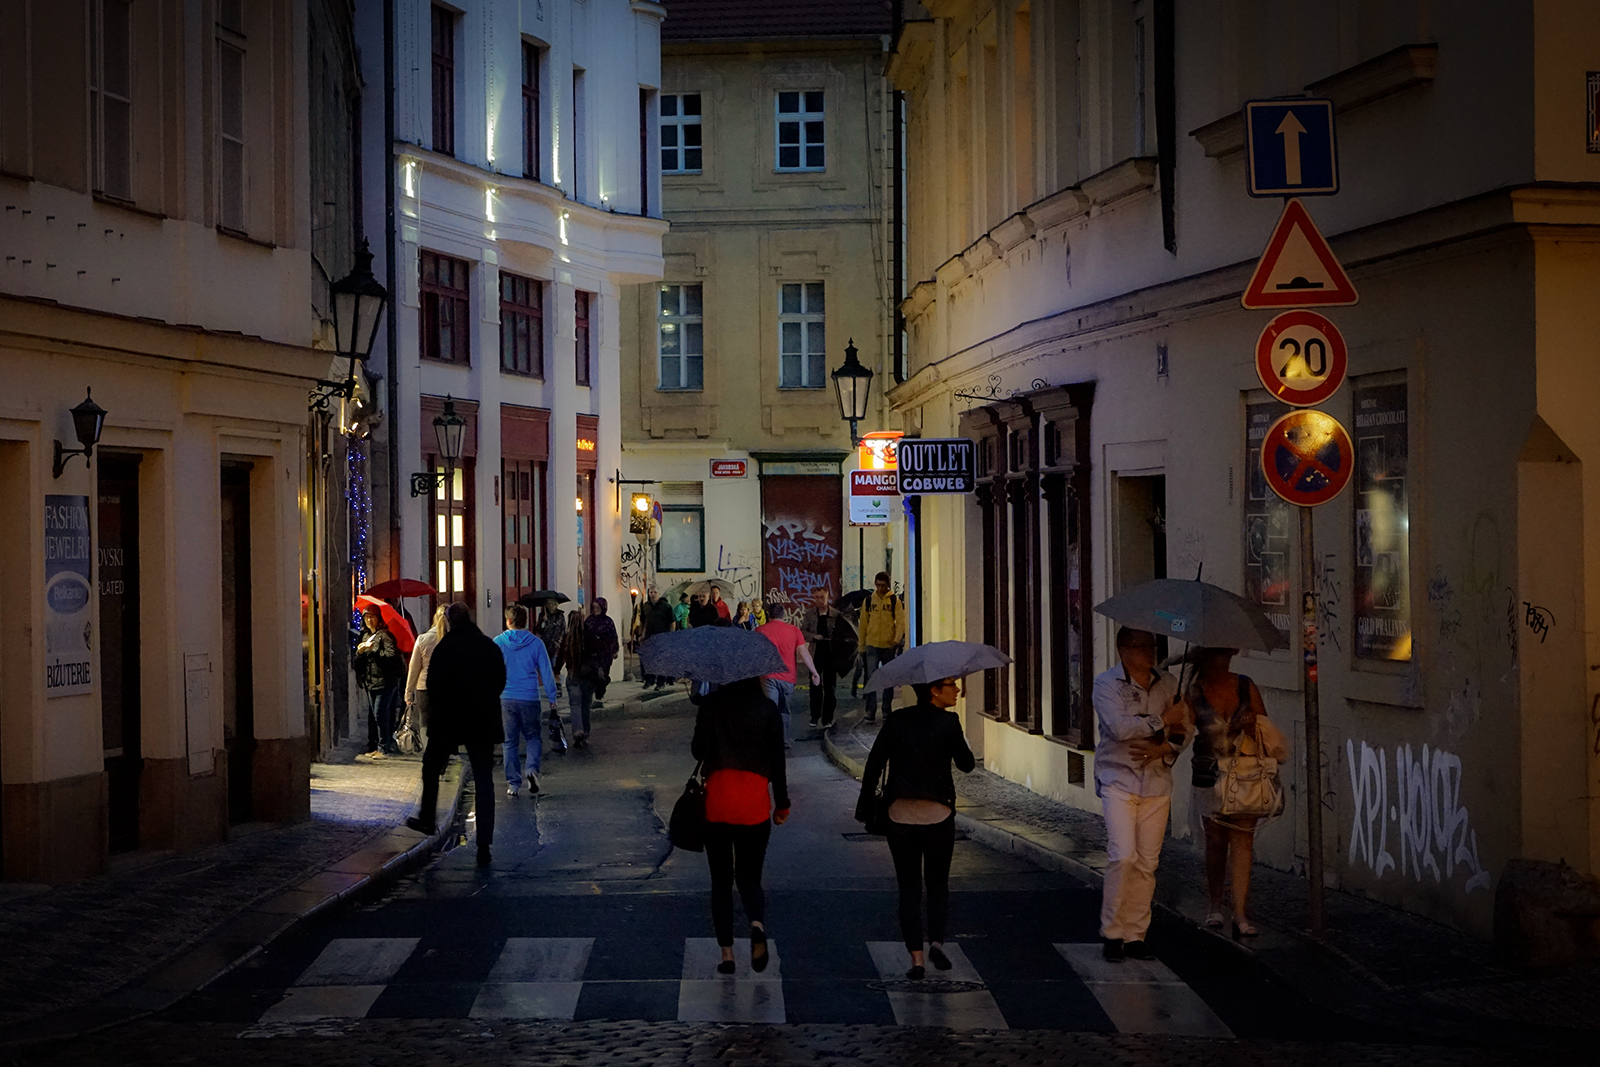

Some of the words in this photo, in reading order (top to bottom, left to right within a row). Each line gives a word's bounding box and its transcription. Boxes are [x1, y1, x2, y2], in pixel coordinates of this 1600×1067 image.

[1279, 338, 1326, 377] 20
[1376, 410, 1406, 426] CHOCOLATE
[901, 443, 970, 472] OUTLET
[855, 474, 896, 485] MANGO
[903, 478, 965, 491] COBWEB
[45, 505, 88, 529] FASHION
[45, 536, 91, 560] JEWELRY
[1358, 616, 1375, 634] GOLD
[1375, 618, 1408, 637] PRALINES
